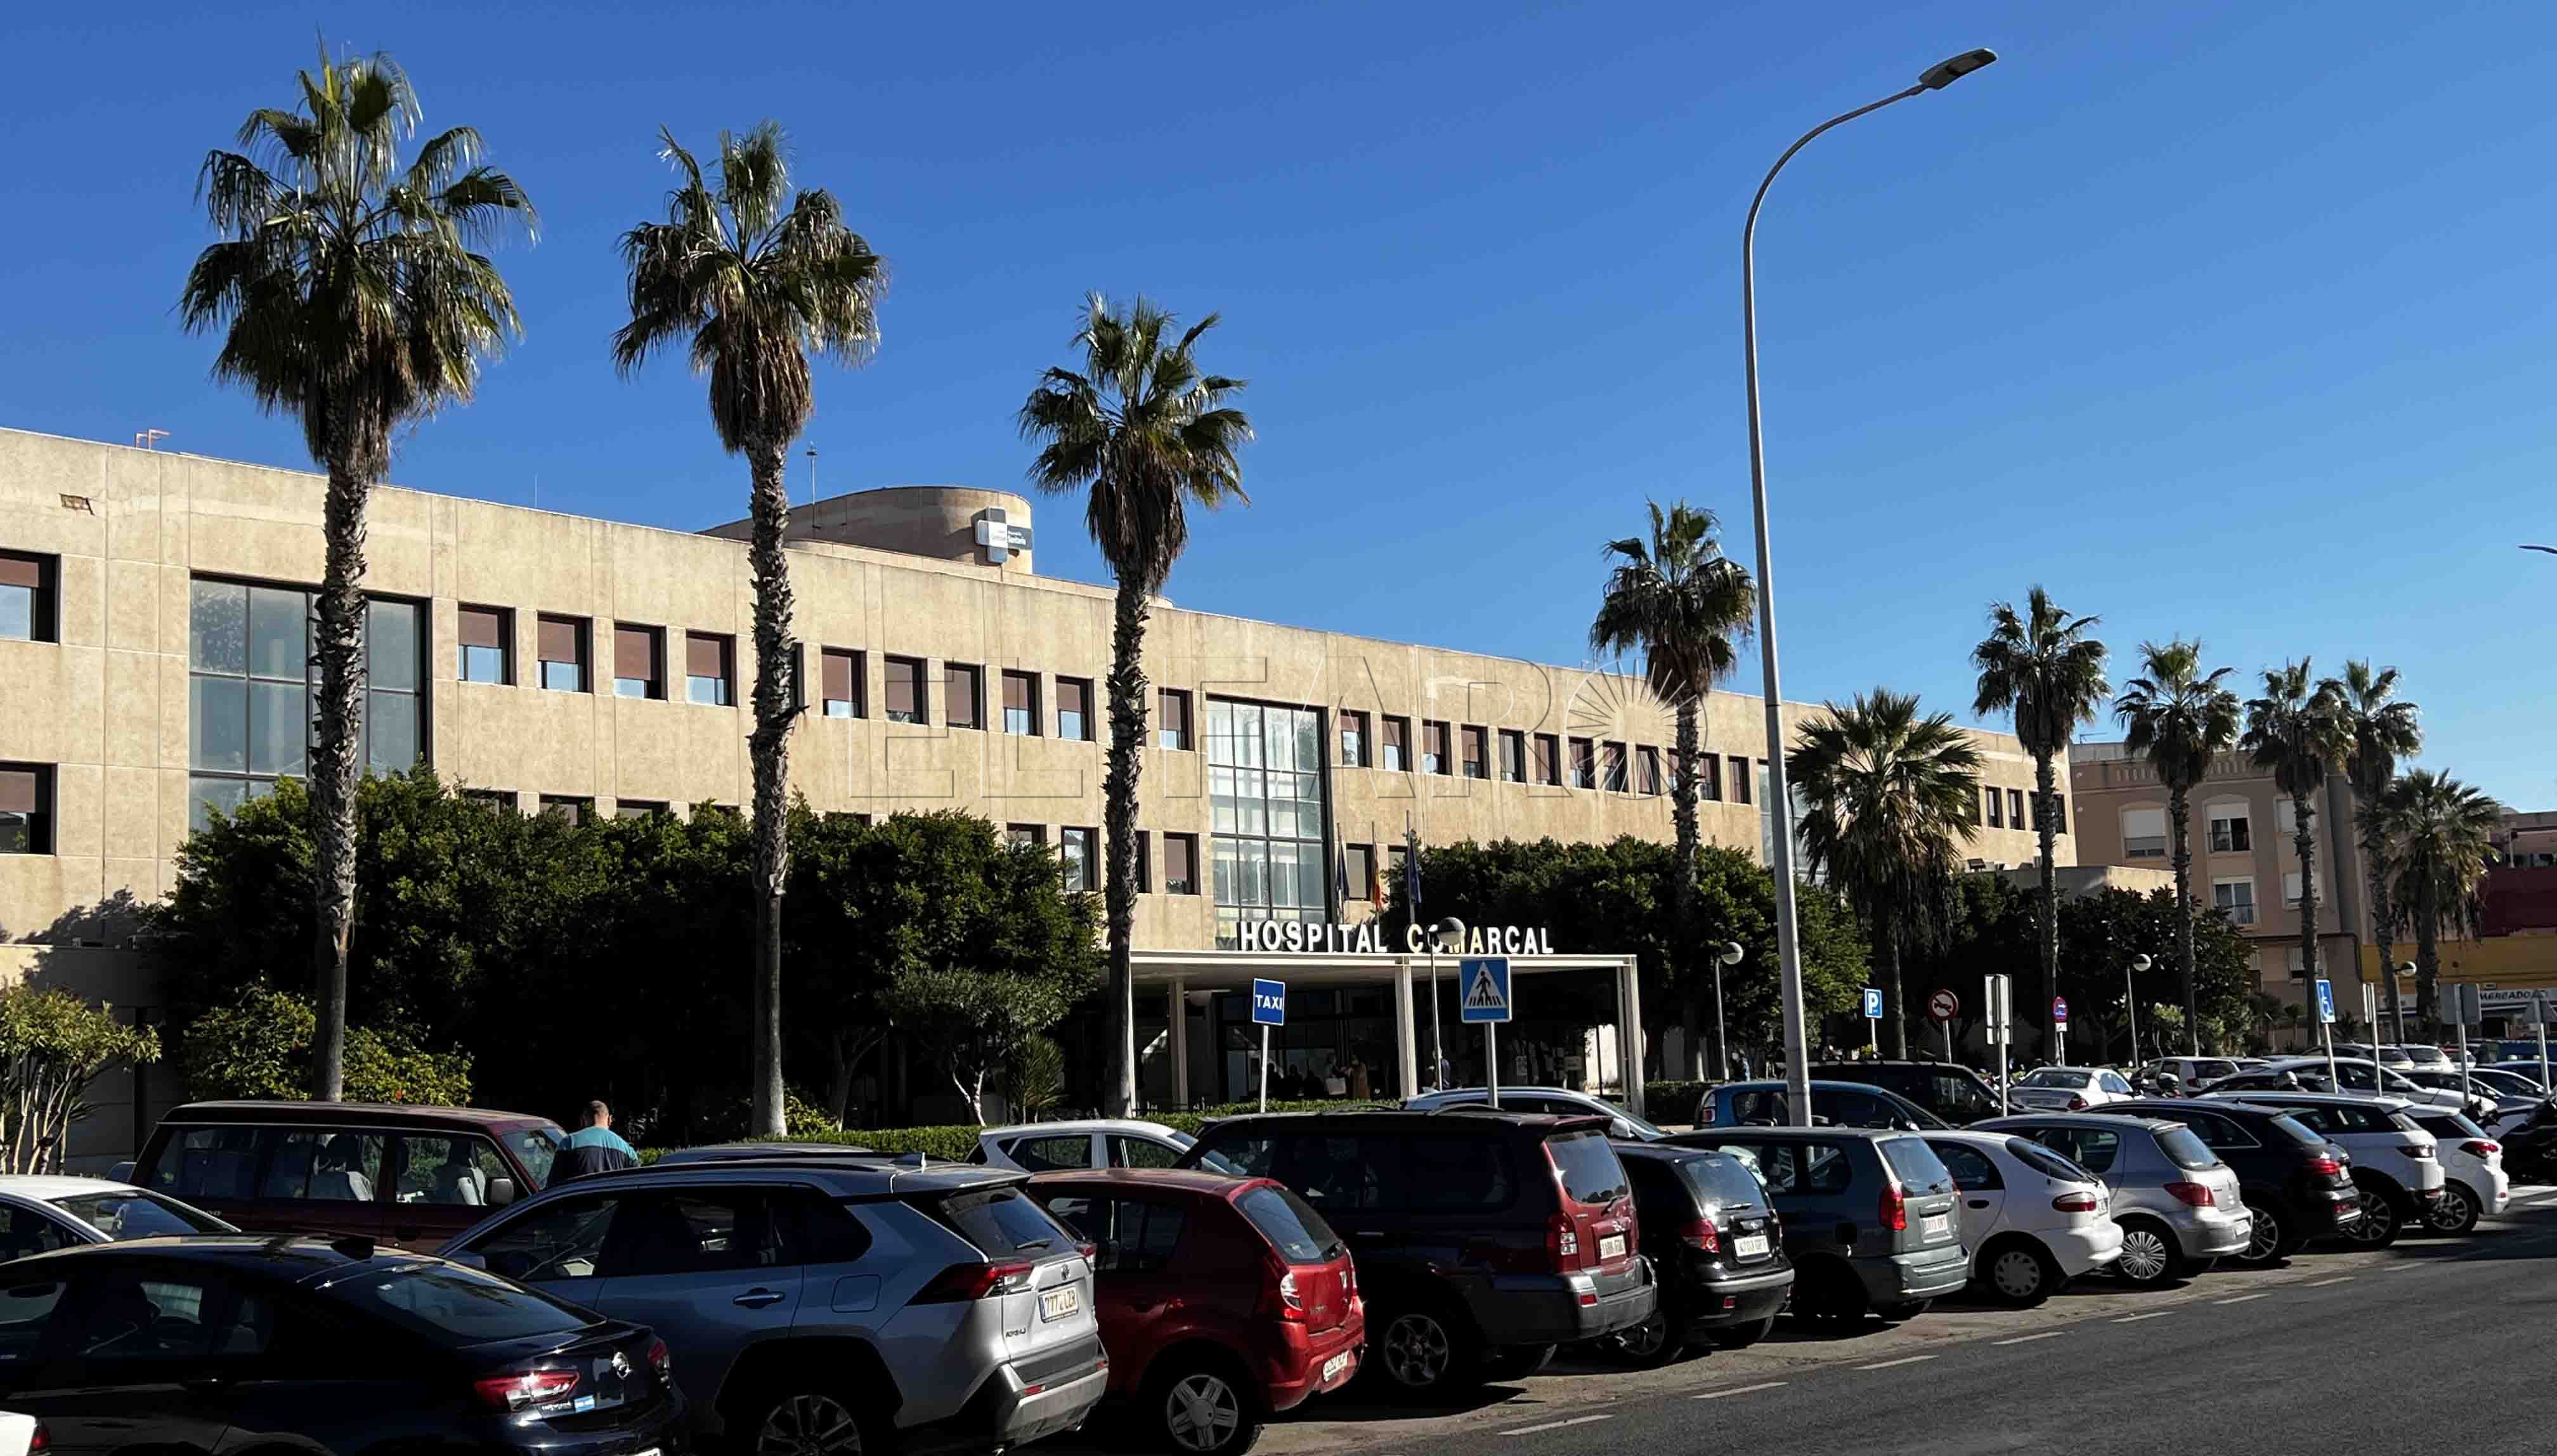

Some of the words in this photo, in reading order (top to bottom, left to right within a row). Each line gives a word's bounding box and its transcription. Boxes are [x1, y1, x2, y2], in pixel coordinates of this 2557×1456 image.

[1239, 920, 1388, 953] HOSPITAL
[1255, 994, 1284, 1010] TAXI
[1868, 992, 1878, 1014] P
